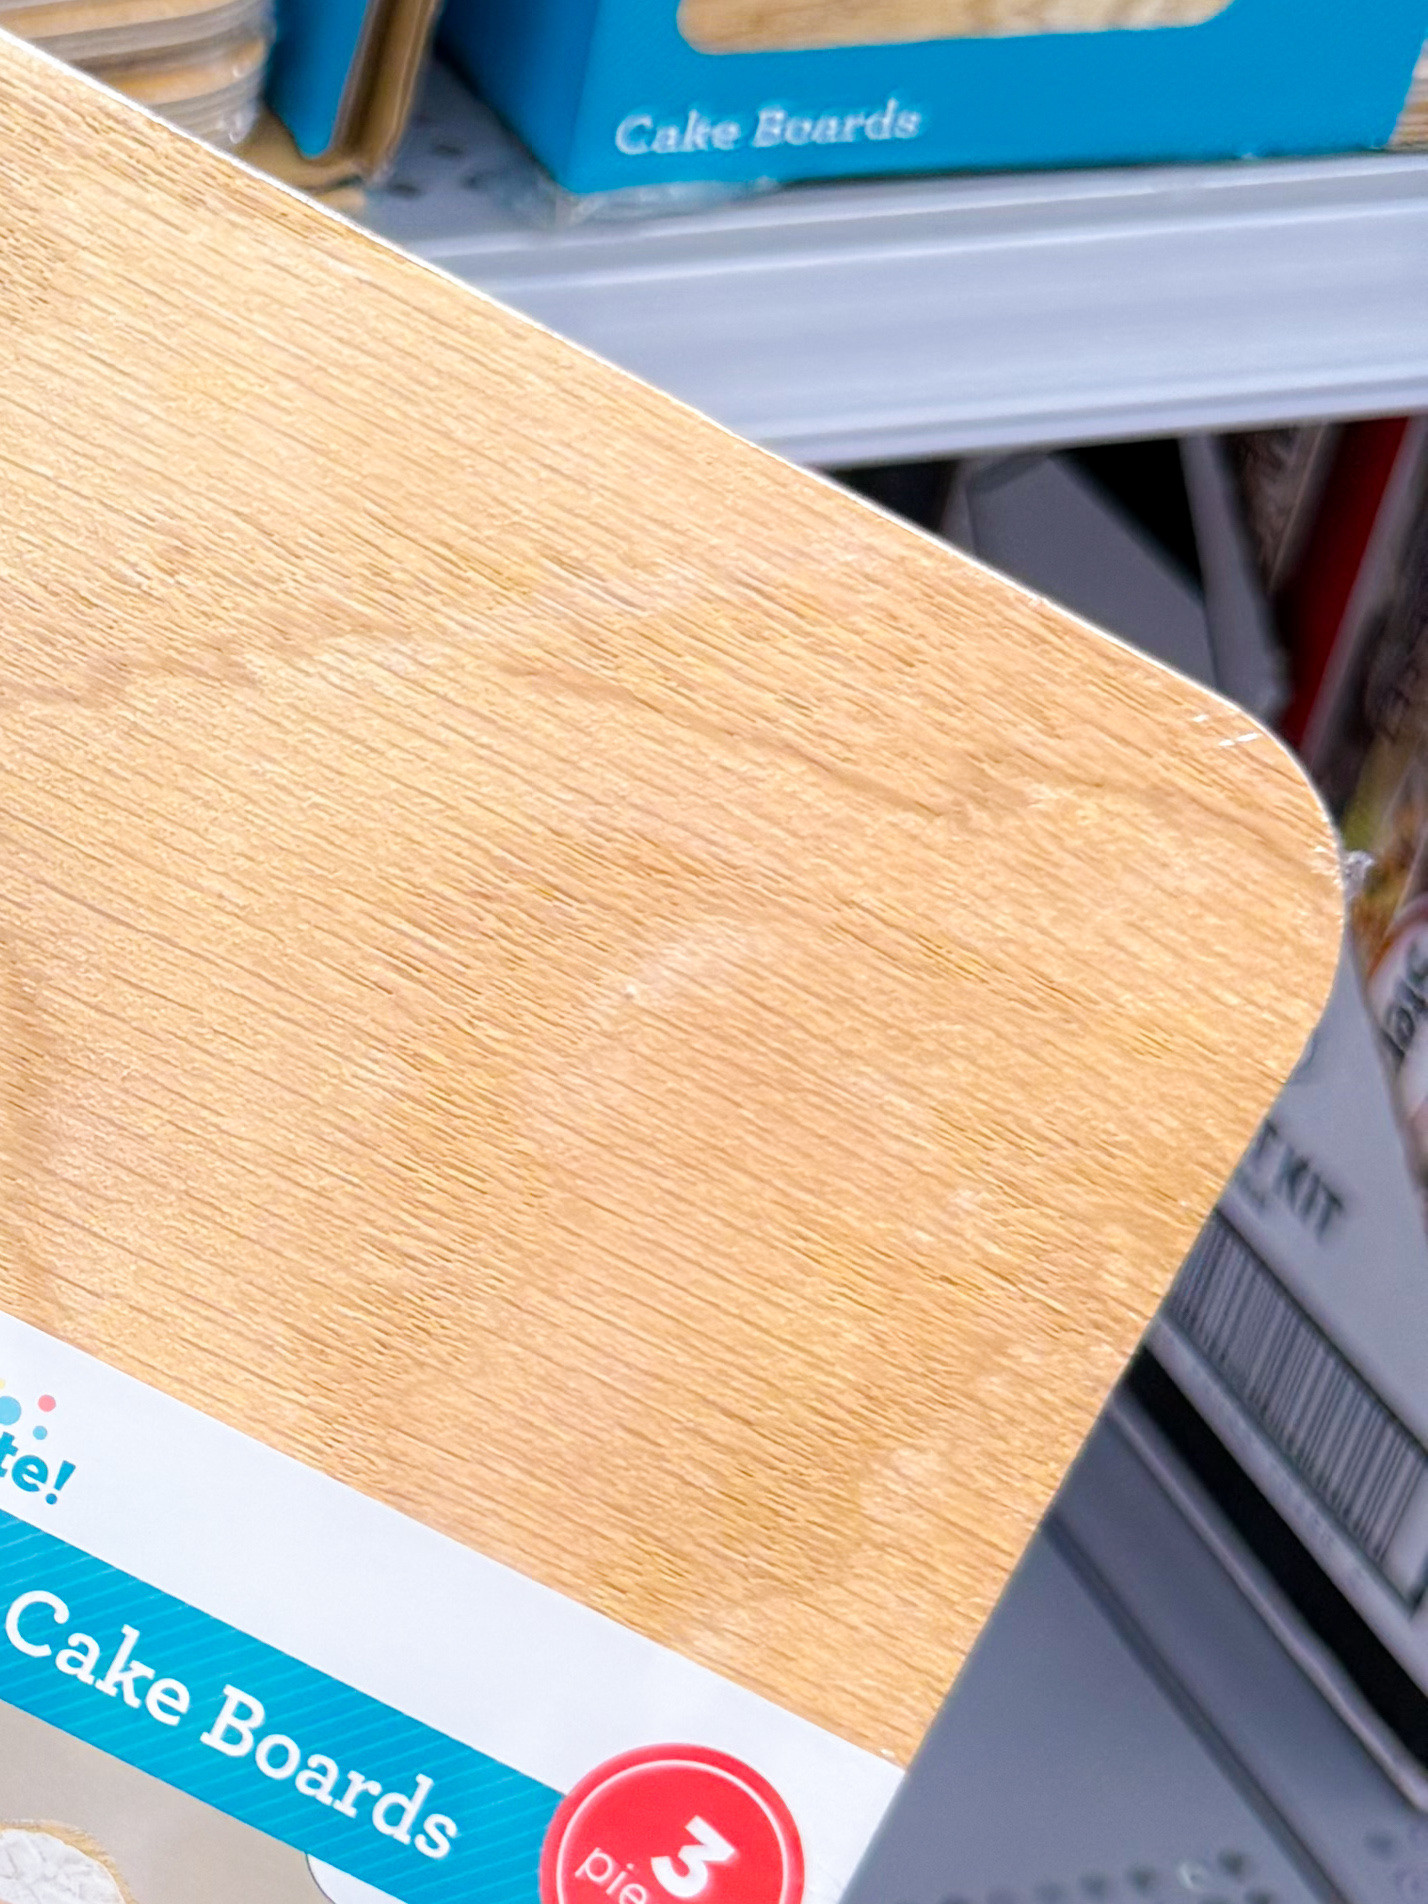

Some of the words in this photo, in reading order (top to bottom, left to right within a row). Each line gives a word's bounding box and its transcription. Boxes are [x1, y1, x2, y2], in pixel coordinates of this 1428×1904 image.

[615, 108, 742, 156] Cake
[750, 97, 922, 148] Boards
[5, 1590, 191, 1726] Cake
[200, 1684, 459, 1859] Boards
[650, 1815, 737, 1899] 3
